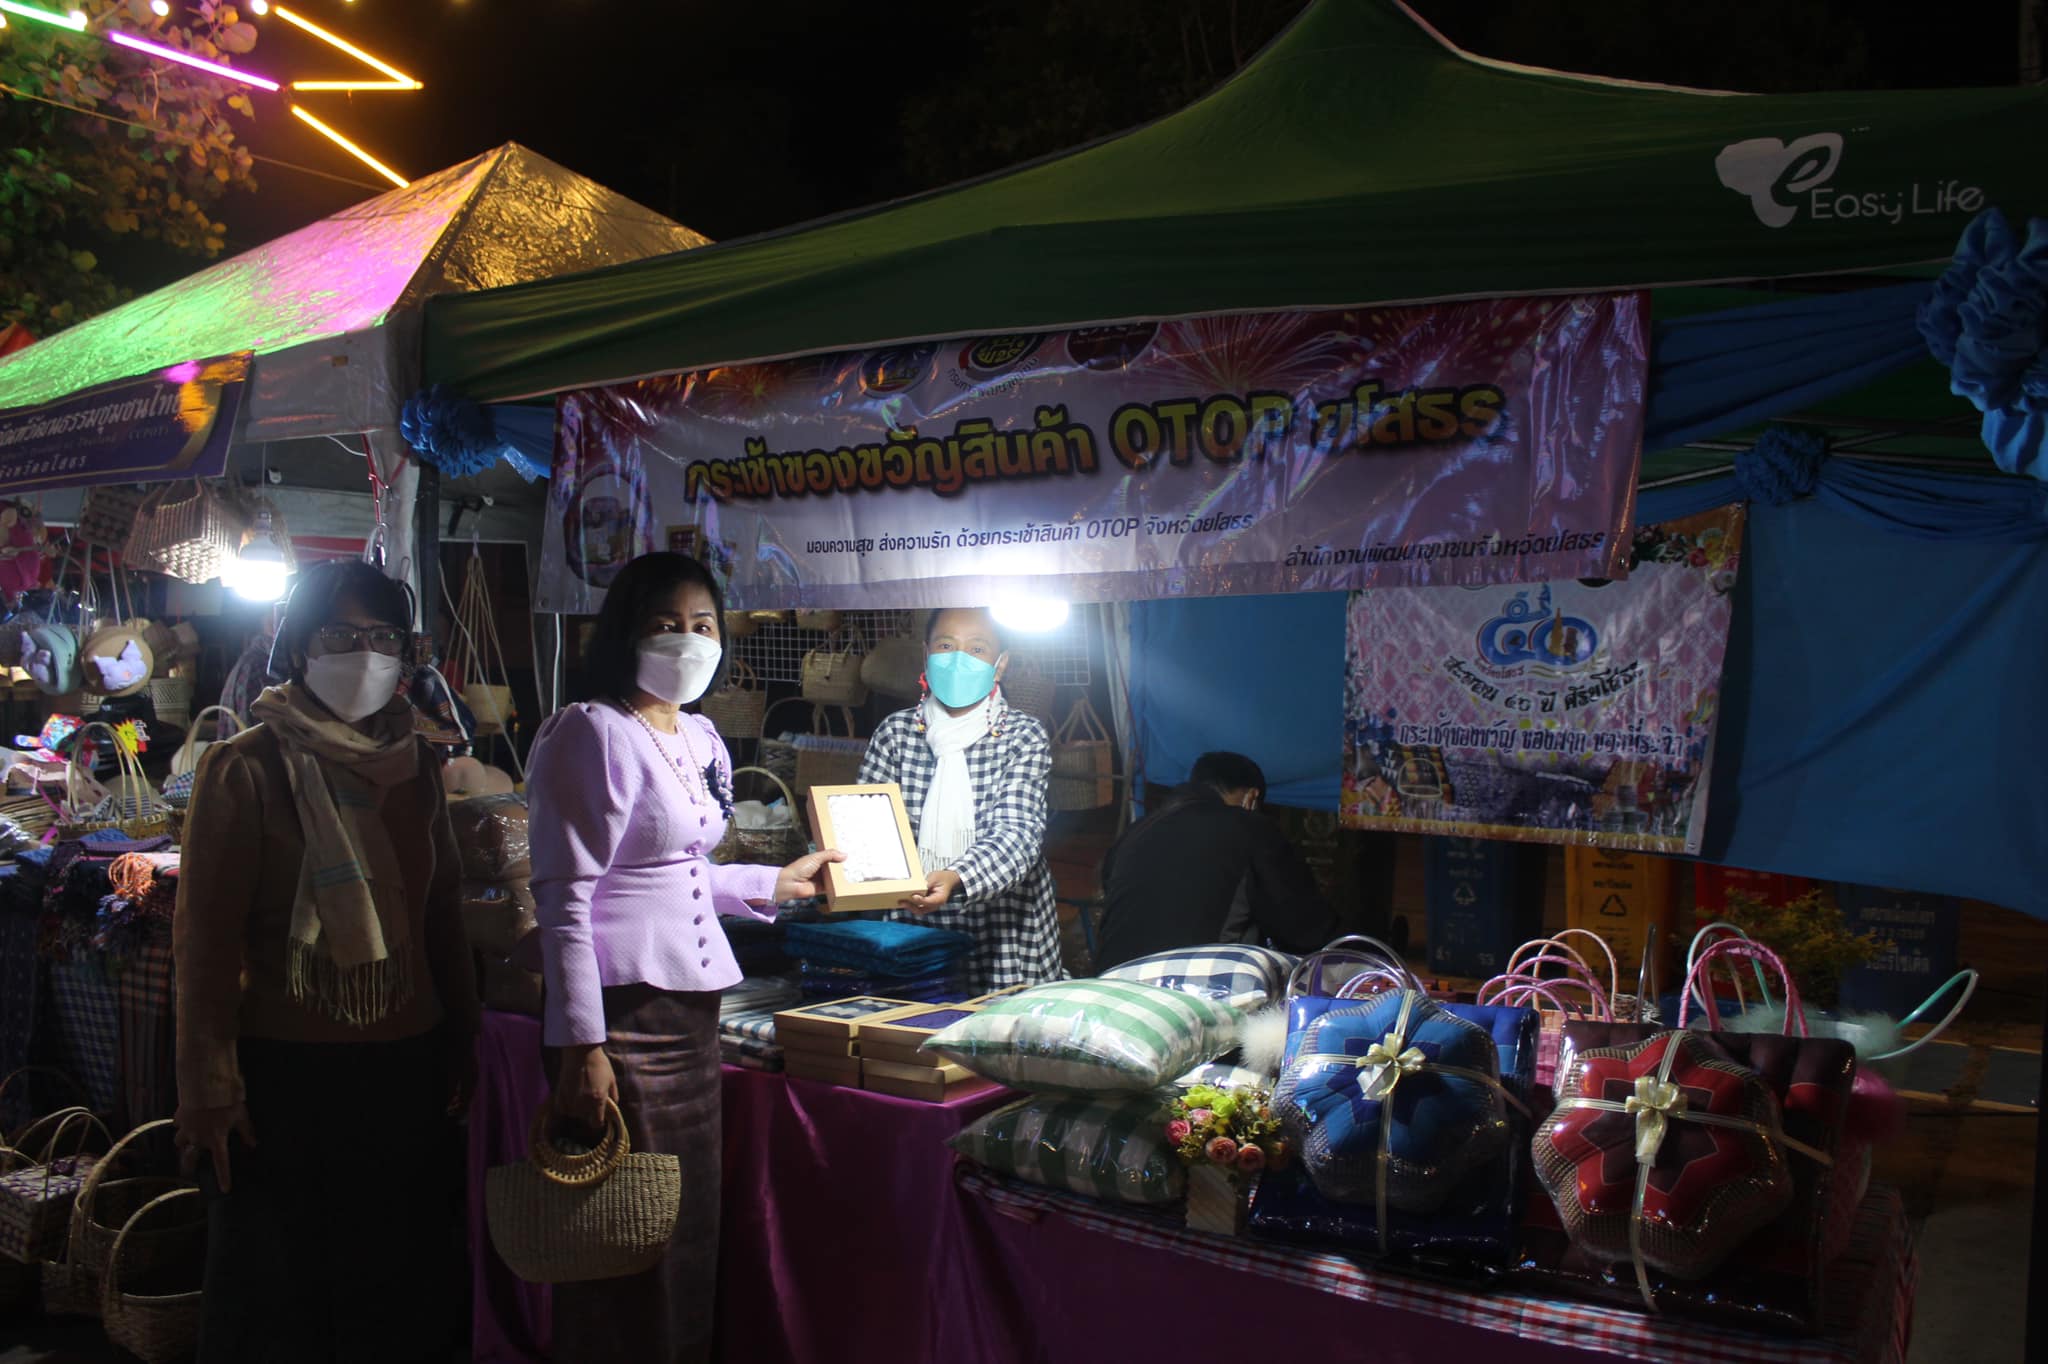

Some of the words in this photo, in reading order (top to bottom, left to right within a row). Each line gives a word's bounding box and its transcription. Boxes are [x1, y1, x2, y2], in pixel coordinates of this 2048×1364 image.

[1811, 187, 1903, 224] Easy
[1912, 178, 1985, 215] Life
[684, 403, 1100, 503] กระเช้าของขวัญสินค้า
[1109, 391, 1291, 474] OTOP
[1312, 379, 1507, 452] ยโสธร
[806, 536, 875, 558] มอบความสุข
[878, 530, 951, 553] ส่งความรัก
[956, 525, 1082, 551] ด้วยกระเช้าสินค้า
[1087, 516, 1140, 541] OTOP
[1144, 511, 1255, 537] จังหวัดยโสธร
